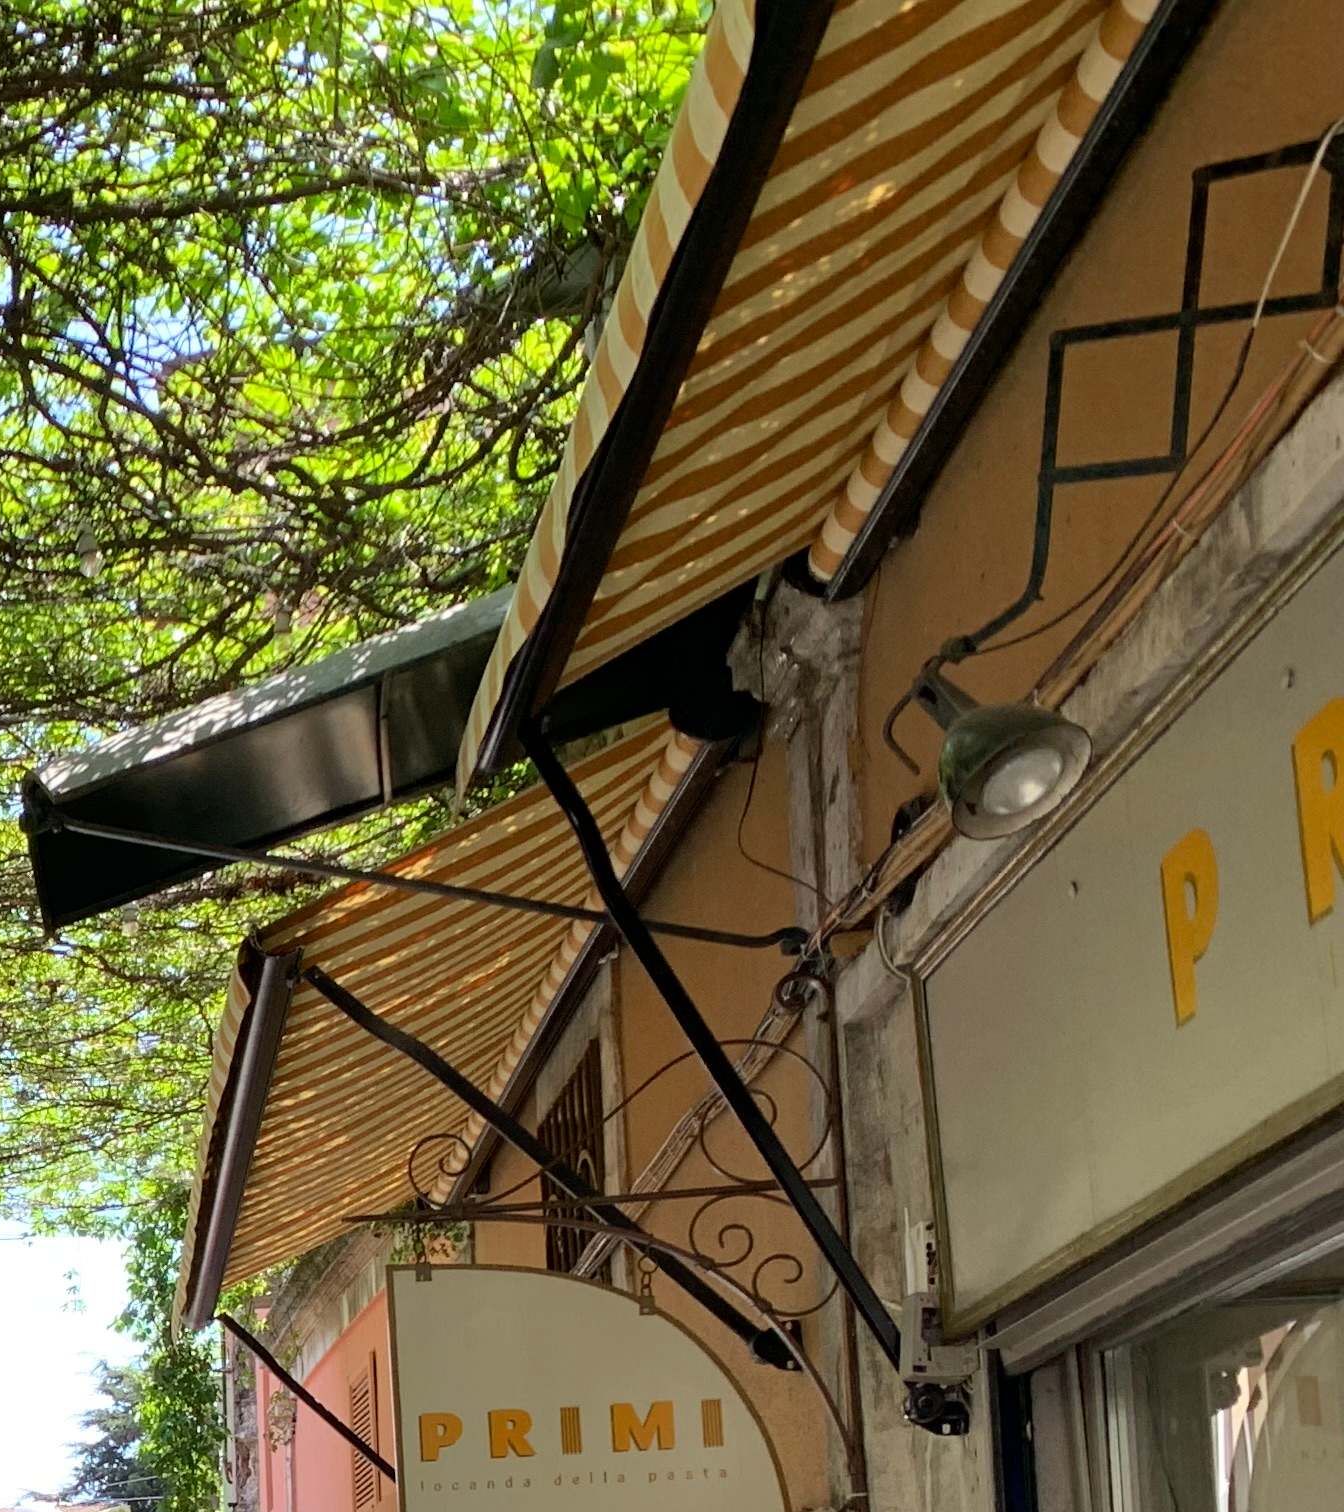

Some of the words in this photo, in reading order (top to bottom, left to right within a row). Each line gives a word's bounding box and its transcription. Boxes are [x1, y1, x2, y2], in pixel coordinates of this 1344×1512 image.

[418, 1398, 724, 1462] PRIMI
[420, 1477, 531, 1492] locanda
[554, 1471, 626, 1487] della
[648, 1467, 728, 1484] pasta
